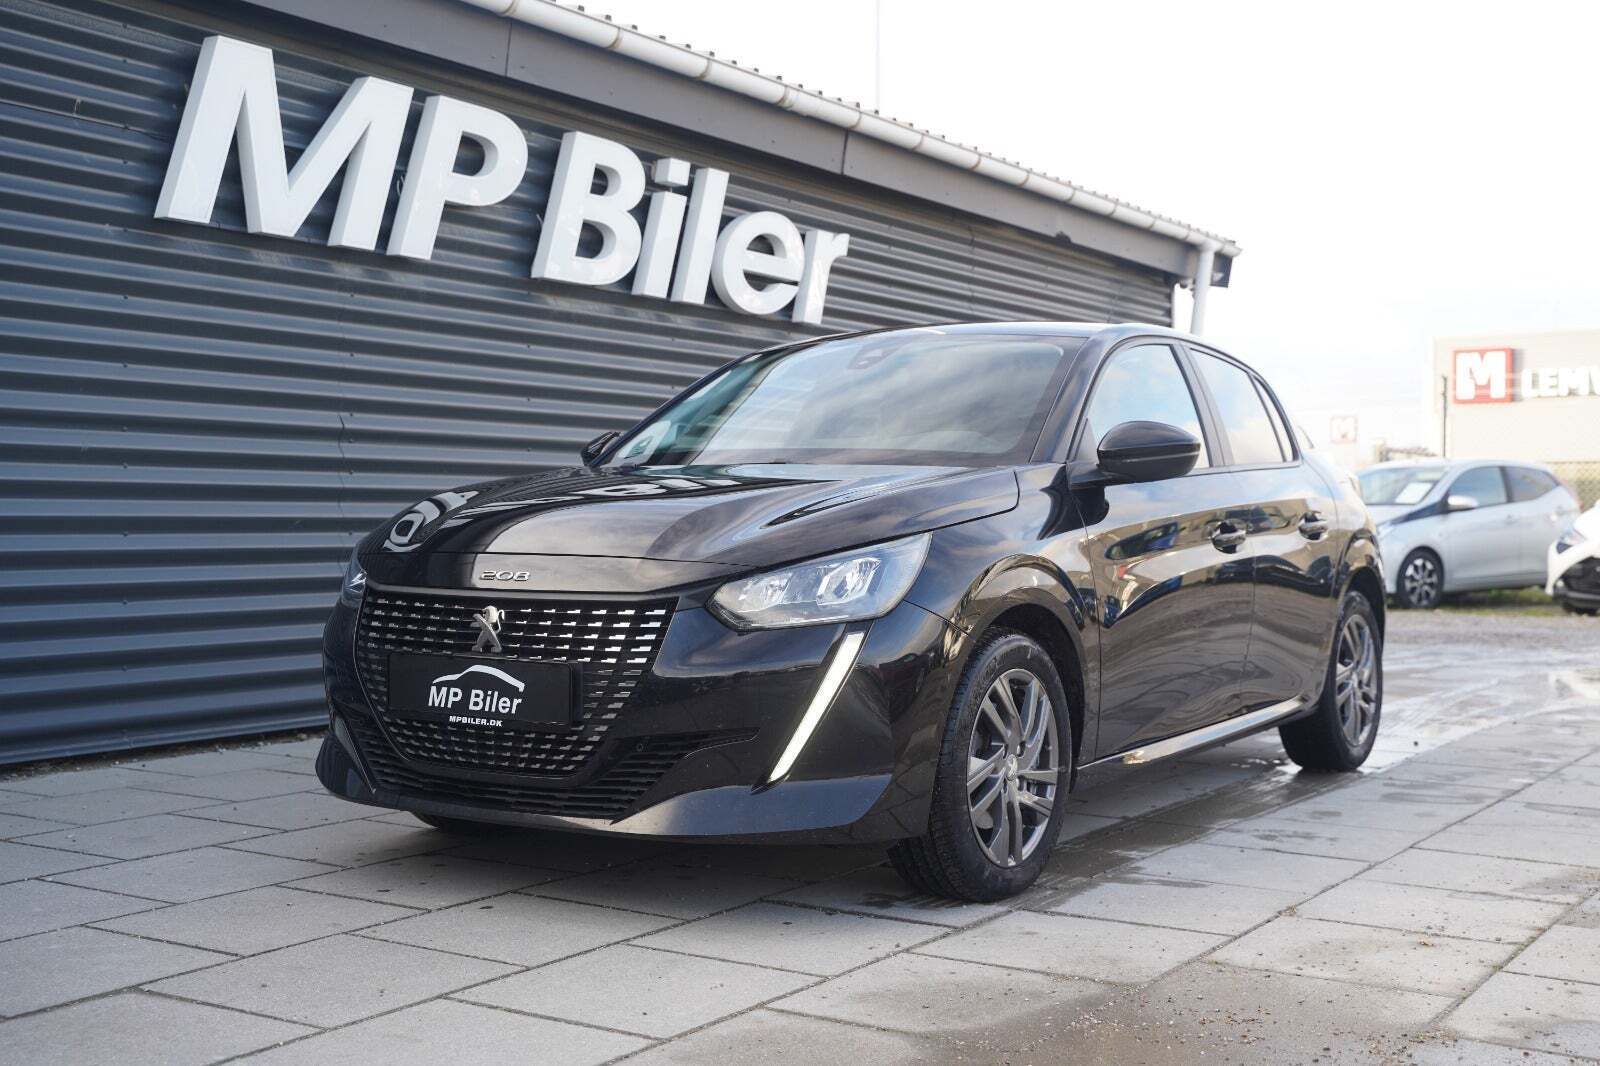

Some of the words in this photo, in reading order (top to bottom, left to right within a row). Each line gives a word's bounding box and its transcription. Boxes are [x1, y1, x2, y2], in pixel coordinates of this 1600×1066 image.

[153, 34, 529, 261] MP
[530, 130, 850, 325] Biler
[1455, 350, 1507, 400] M
[480, 570, 530, 581] 208
[428, 685, 463, 708] MP
[468, 689, 523, 714] Biler
[448, 715, 504, 727] MPBILER.DK
